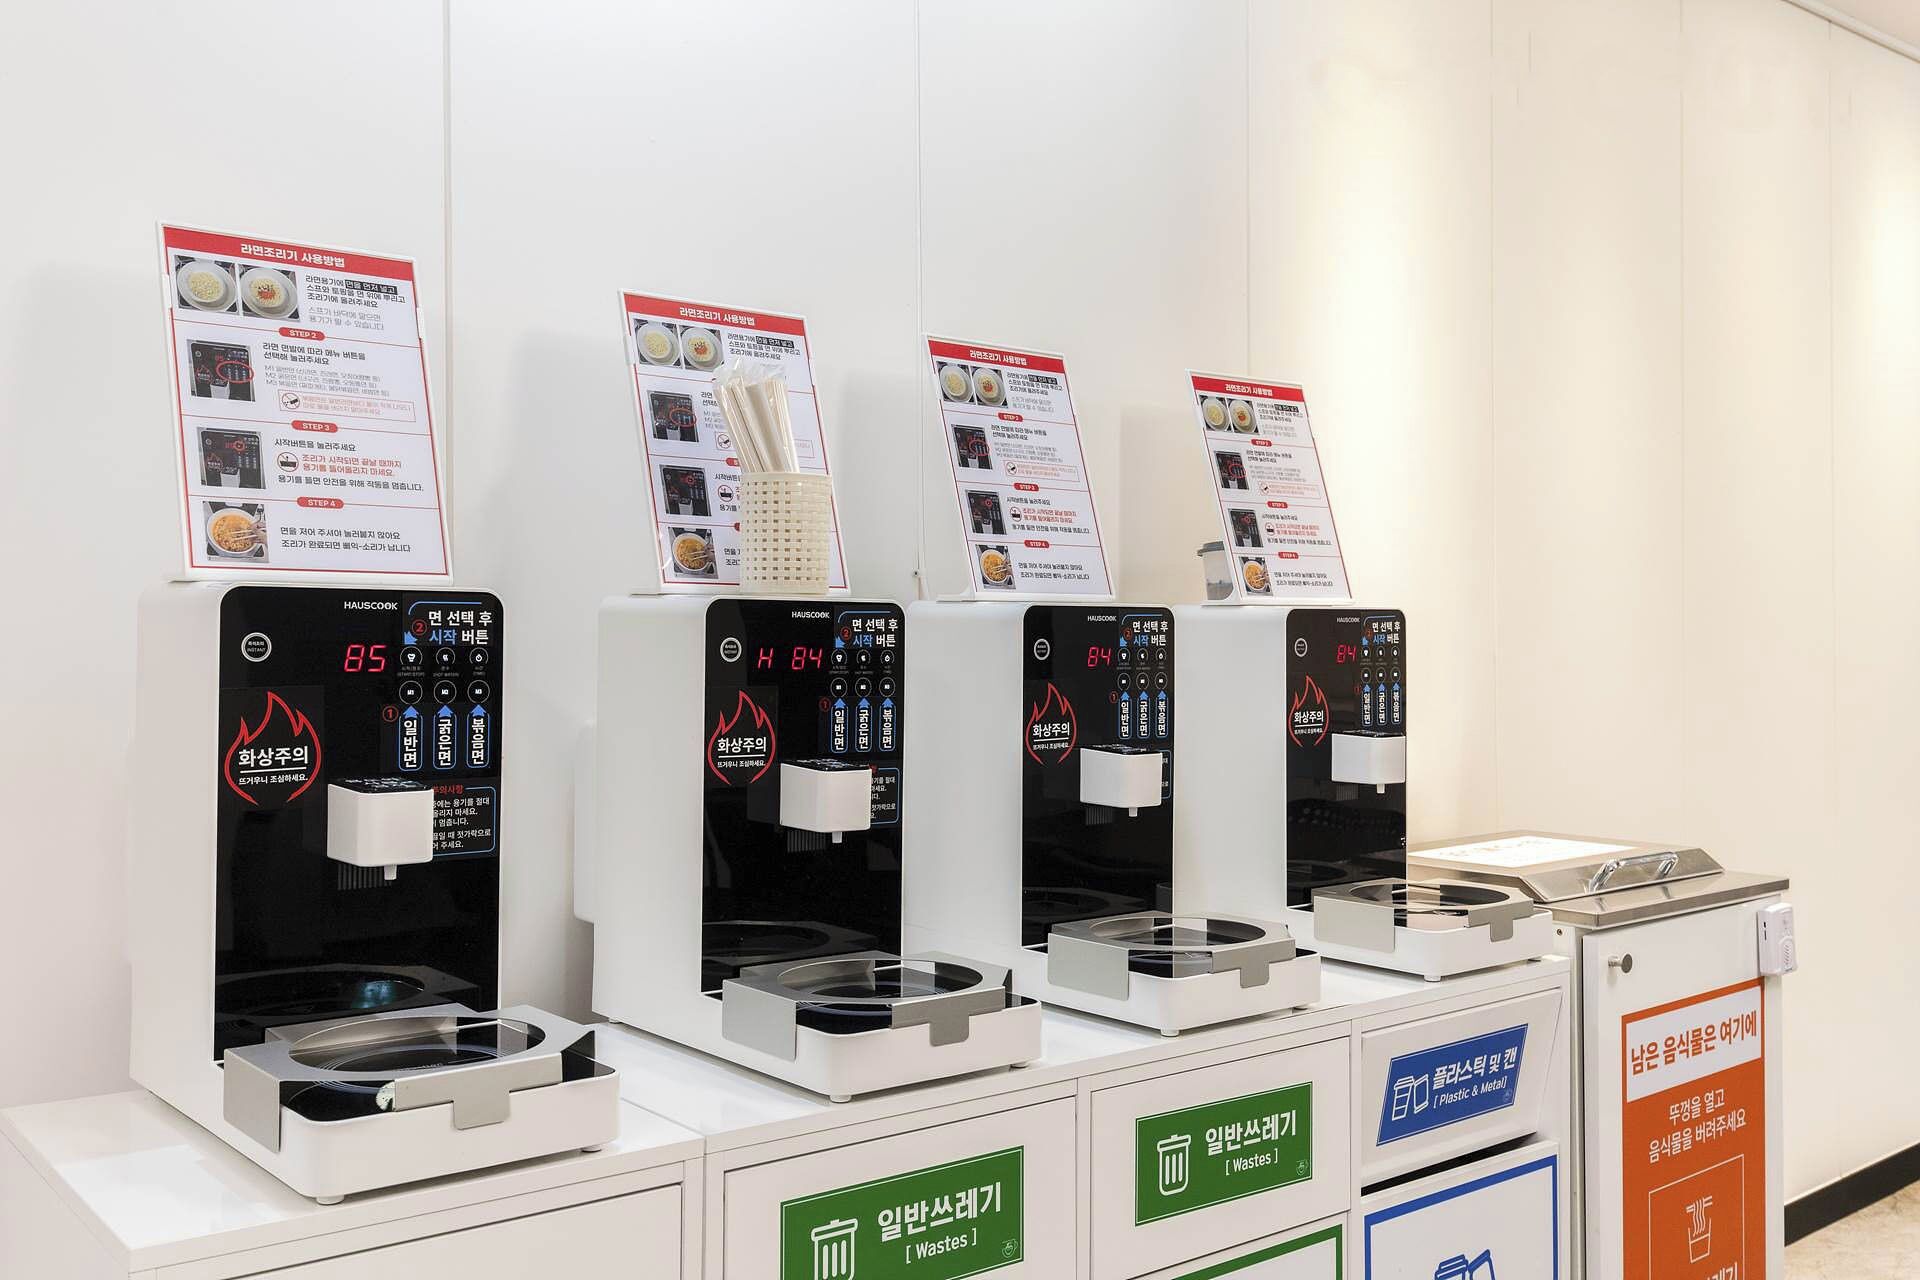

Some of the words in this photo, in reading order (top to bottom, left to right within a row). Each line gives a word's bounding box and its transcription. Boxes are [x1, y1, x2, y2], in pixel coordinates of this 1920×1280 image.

[241, 244, 297, 261] 라면조리기
[302, 253, 344, 267] 사용방법
[306, 275, 344, 286] 라면용기에
[346, 280, 361, 289] 면을
[363, 282, 378, 291] 먼저
[307, 284, 329, 293] 스프와
[307, 293, 338, 303] 조리기에
[680, 307, 721, 321] 라면조리기
[723, 313, 755, 326] 사용방법
[289, 330, 310, 338] STEP
[263, 342, 279, 351] 라면
[307, 348, 323, 356] 따라
[970, 350, 1001, 362] 라면조리기
[275, 438, 314, 449] 시작버튼을
[317, 441, 356, 452] 눌러주세요
[302, 454, 326, 463] 조리가
[329, 455, 359, 465] 시작되면
[303, 463, 327, 472] 용기를
[278, 474, 302, 484] 용기를
[305, 476, 321, 485] 들면
[323, 478, 347, 487] 안전을
[349, 479, 365, 488] 위해
[367, 480, 390, 489] 작동을
[392, 482, 424, 492] 멈춥니다.
[280, 526, 297, 535] 면을
[299, 527, 316, 536] 저어
[282, 539, 306, 548] 조리가
[308, 540, 340, 550] 완료되면
[344, 601, 398, 610] HAUSCOOK
[429, 610, 442, 626] 면
[447, 611, 474, 626] 선택
[479, 611, 492, 626] 후
[791, 611, 830, 619] HAUSCOOK
[852, 619, 862, 632] 면
[865, 619, 885, 632] 선택
[888, 619, 898, 632] 후
[1133, 621, 1140, 632] 면
[1143, 621, 1158, 632] 선택
[1160, 621, 1168, 632] 후
[1372, 622, 1378, 632] 면
[1380, 622, 1392, 632] 선택
[1394, 622, 1400, 631] 후
[429, 630, 457, 645] 시작
[461, 630, 489, 645] 버튼
[853, 634, 873, 647] 시작
[876, 634, 896, 647] 버튼
[1133, 635, 1149, 646] 시작
[1151, 634, 1166, 646] 버튼
[1374, 634, 1385, 644] 시작
[1387, 634, 1399, 644] 버튼
[344, 644, 386, 672] 85
[758, 648, 774, 668] H
[792, 647, 823, 670] 84
[1088, 647, 1111, 667] 84
[1336, 644, 1356, 664] 84
[1121, 702, 1130, 737] 일반면
[1140, 701, 1148, 736] 굵은면
[1158, 701, 1166, 735] 볶음면
[1294, 710, 1323, 723] 화상주의
[835, 710, 844, 750] 일반면
[859, 710, 869, 749] 굵은면
[883, 709, 892, 748] 볶음면
[1033, 722, 1069, 737] 화상주의
[404, 720, 418, 768] 일반면
[438, 719, 452, 766] 굵은면
[471, 718, 485, 765] 볶음면
[718, 737, 766, 753] 화상주의
[239, 745, 308, 767] 화상주의
[239, 775, 268, 785] 뜨거우니
[270, 774, 308, 783] 조심하세요.
[453, 799, 473, 807] 용기를
[476, 798, 489, 806] 절대
[455, 808, 478, 817] 마세요.
[439, 818, 469, 827] 멈춥니다.
[448, 831, 455, 839] 때
[457, 829, 491, 839] 젓가락으로
[441, 841, 463, 849] 주세요.
[1631, 1040, 1659, 1076] 남은
[1663, 1024, 1716, 1065] 음식물은
[1720, 1010, 1757, 1045] 여기에
[1432, 1054, 1487, 1090] 플라스틱
[1489, 1053, 1501, 1074] 및
[1504, 1046, 1518, 1070] 캔
[1439, 1089, 1470, 1106] Plastic
[1472, 1086, 1478, 1096] &
[1669, 1094, 1701, 1126] 뚜껑을
[1705, 1088, 1725, 1115] 열고
[1205, 1110, 1297, 1156] 일반쓰레기
[1649, 1127, 1692, 1164] 음식물을
[1695, 1107, 1746, 1143] 버려주세요
[1233, 1153, 1271, 1172] Wastes
[878, 1182, 1001, 1242] 일반쓰레기
[916, 1234, 968, 1259] Wastes
